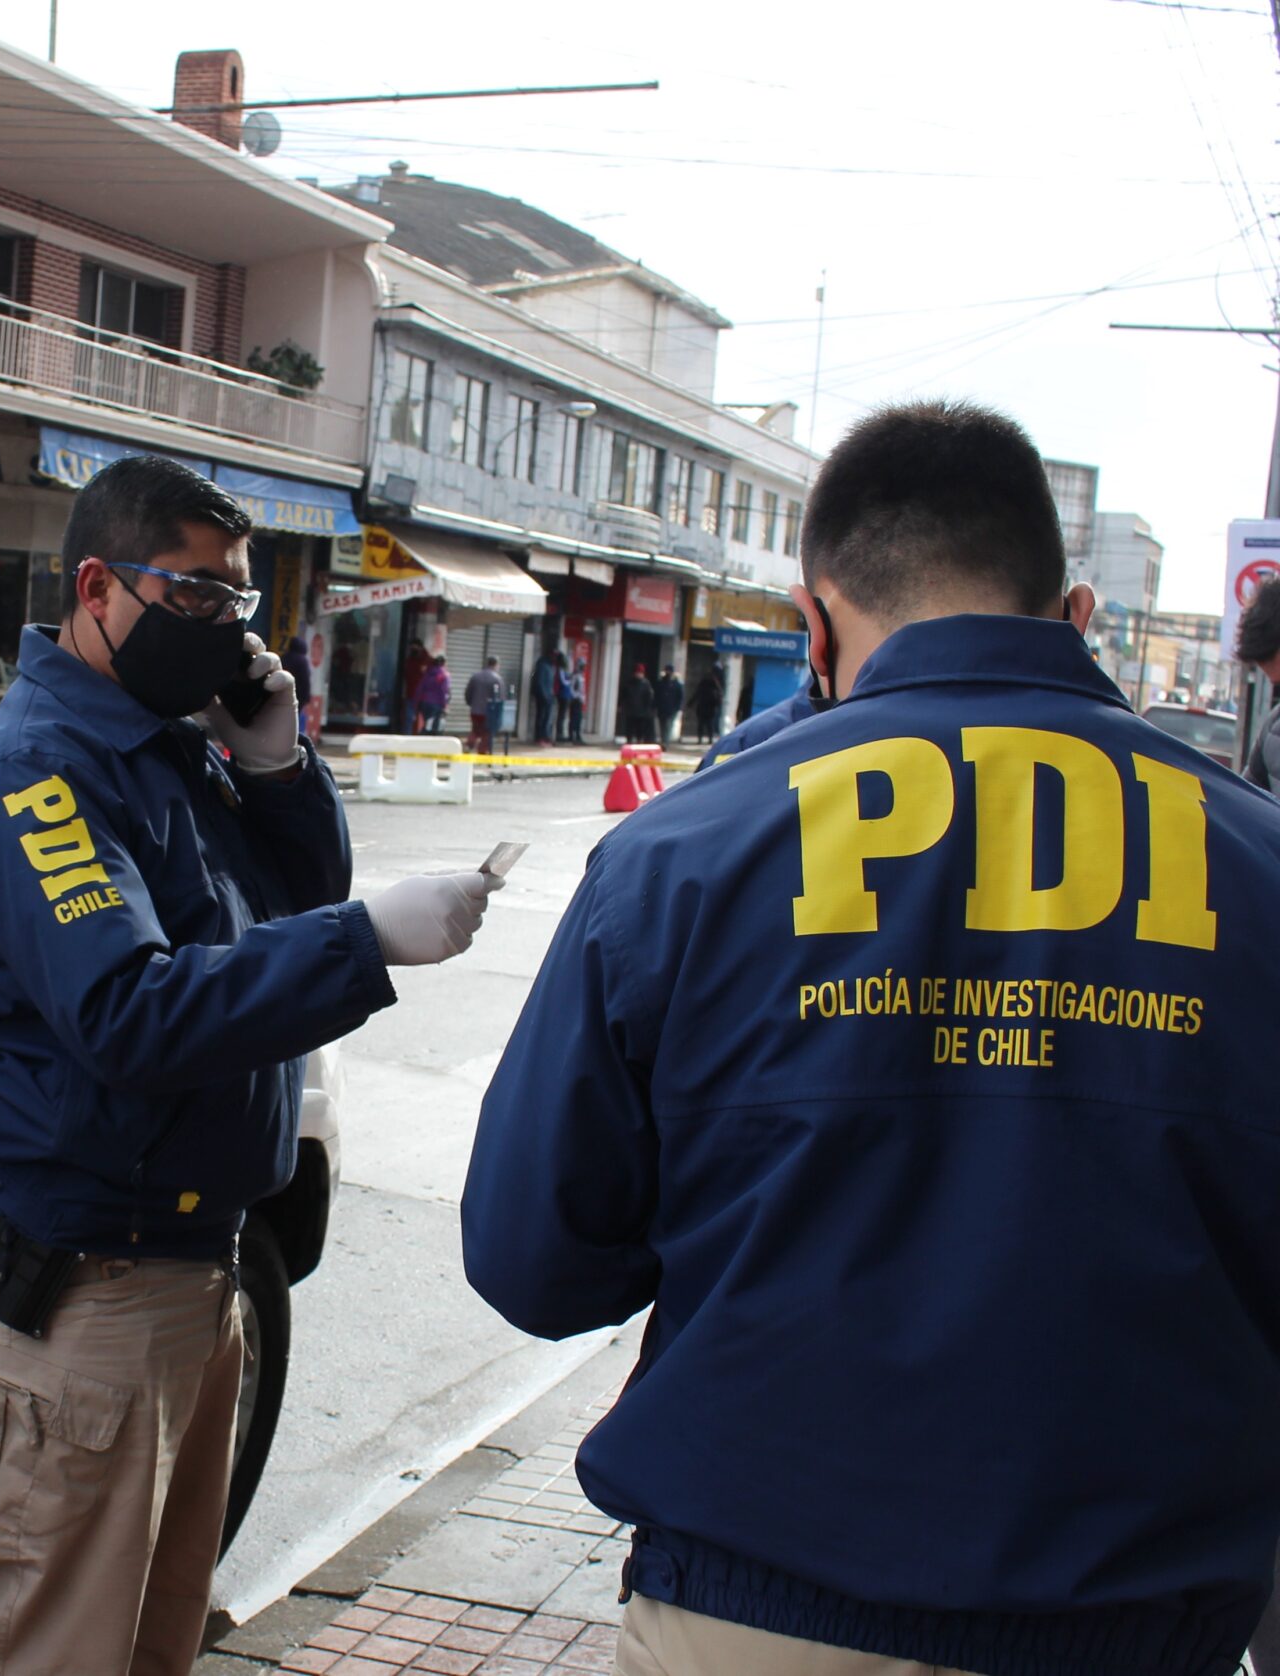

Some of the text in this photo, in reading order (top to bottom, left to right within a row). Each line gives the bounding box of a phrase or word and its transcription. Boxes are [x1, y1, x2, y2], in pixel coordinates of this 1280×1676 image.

[56, 447, 111, 485] CAS
[274, 501, 336, 531] ZARZAR
[322, 581, 425, 610] CASA MAMITA
[721, 633, 798, 651] EL VALDIVIANO
[2, 774, 111, 902] PDI
[788, 726, 1217, 951] PDI
[53, 886, 124, 925] CHILE
[799, 968, 1204, 1036] POLICÍA DE INVESTIGACIONES
[933, 1026, 1056, 1068] DE CHILE
